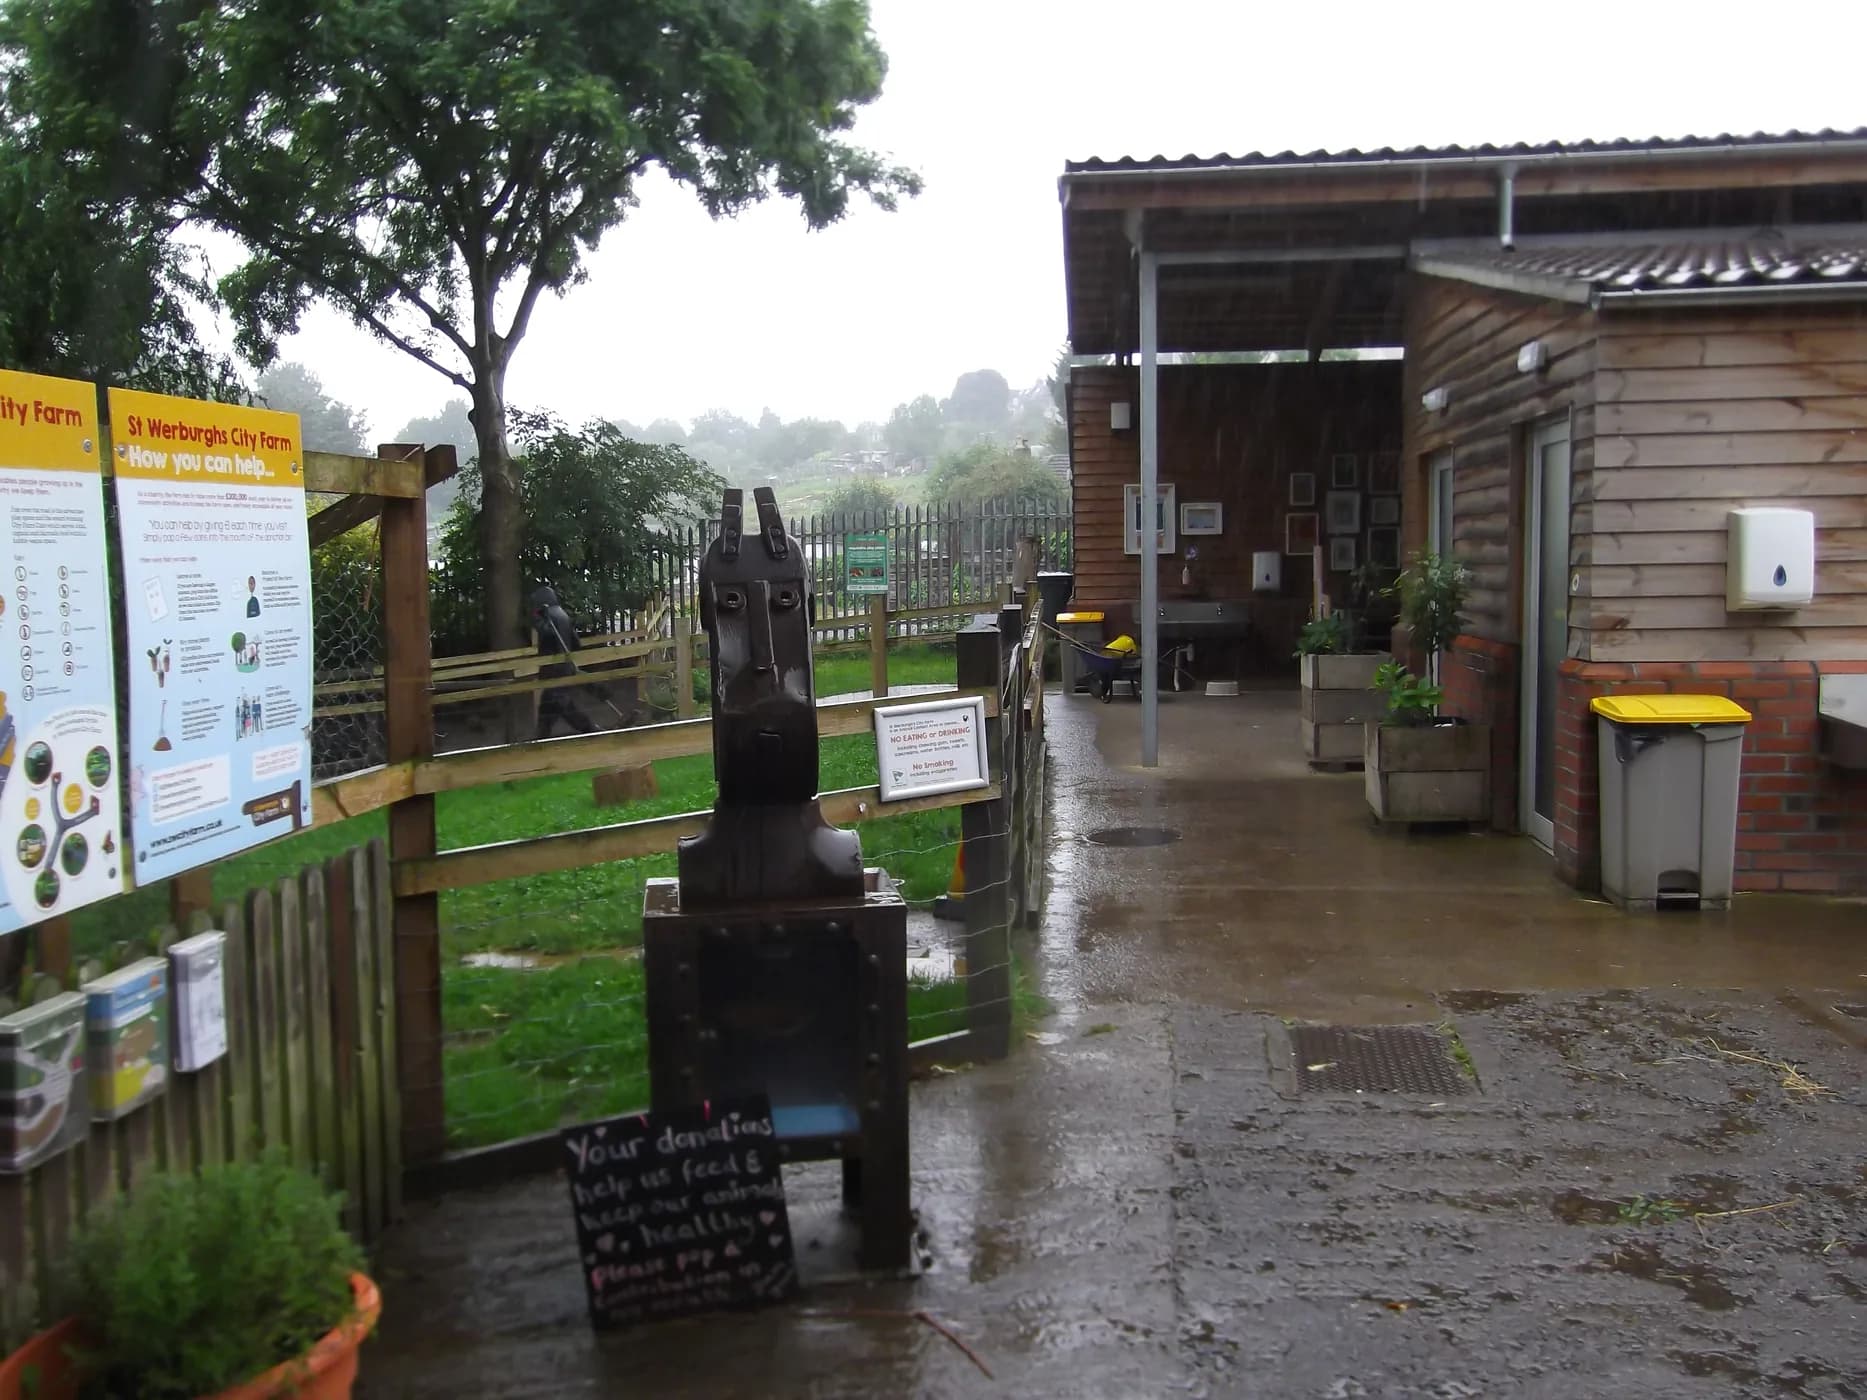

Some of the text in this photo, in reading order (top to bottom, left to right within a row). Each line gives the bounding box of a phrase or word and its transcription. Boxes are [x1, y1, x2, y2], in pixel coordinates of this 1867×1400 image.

[0, 395, 83, 428] ity Farm
[128, 415, 292, 452] St Werburghs City Farm
[128, 445, 276, 481] How you can help...
[890, 736, 901, 744] NO
[903, 732, 928, 742] EATING
[938, 726, 971, 737] DRINKING
[912, 758, 954, 771] No Smoking
[566, 1112, 773, 1174] Your donations
[573, 1174, 633, 1206] help
[640, 1167, 673, 1190] us
[681, 1152, 740, 1187] feed
[579, 1202, 645, 1233] keep
[650, 1193, 692, 1215] our
[639, 1210, 756, 1247] healthy
[675, 1247, 716, 1273] pop
